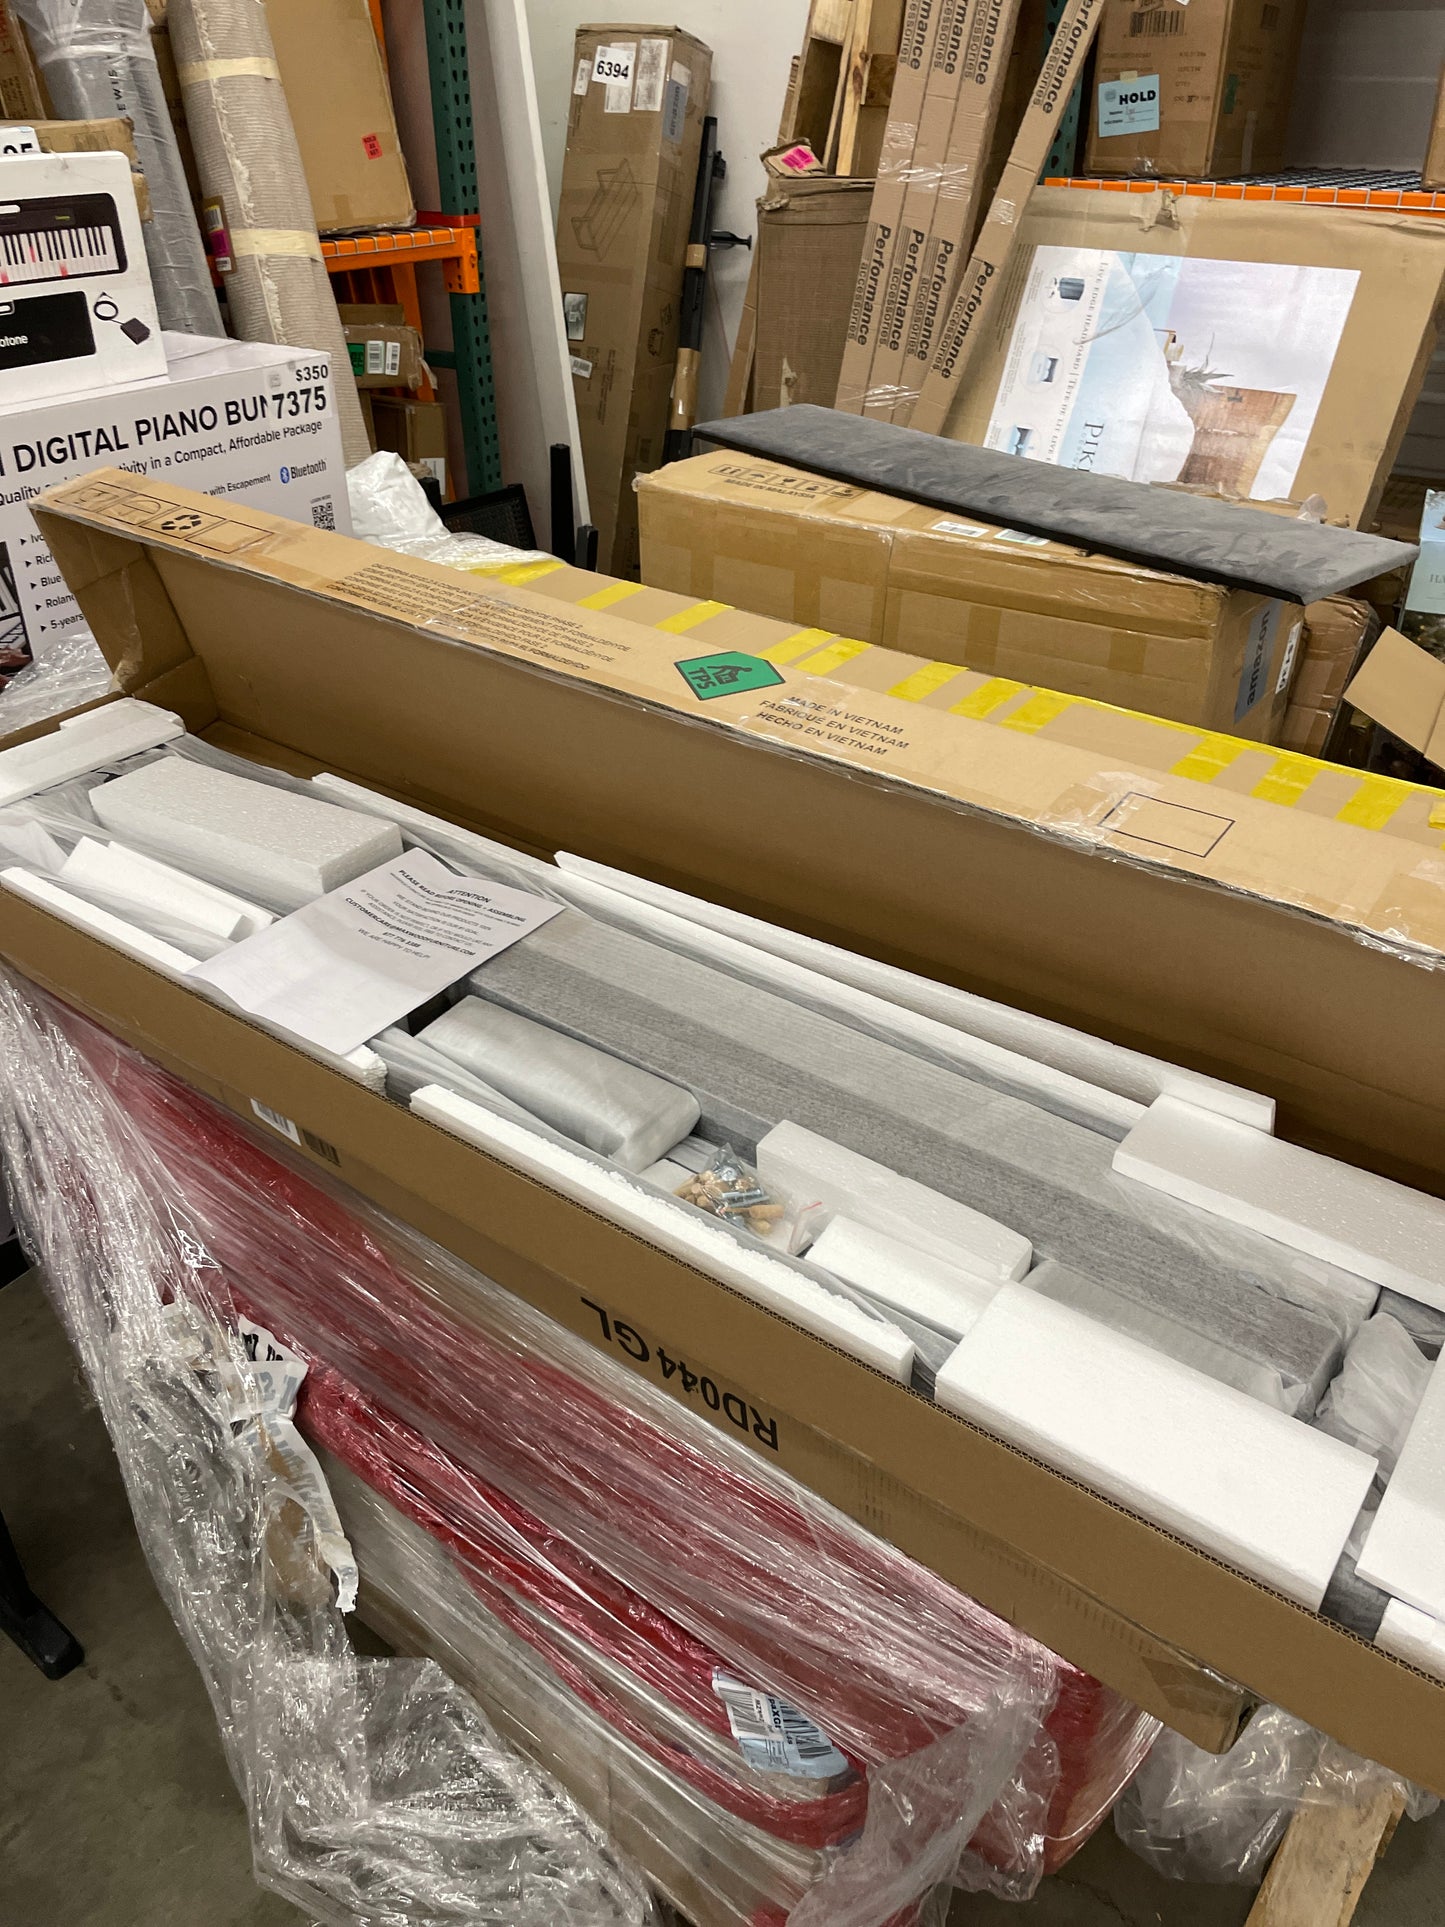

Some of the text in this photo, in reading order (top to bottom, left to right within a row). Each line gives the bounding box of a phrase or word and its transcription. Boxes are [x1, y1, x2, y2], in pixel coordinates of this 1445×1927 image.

[596, 60, 629, 78] 6394
[1119, 90, 1156, 105] HOLD
[857, 224, 892, 346] Performance
[889, 228, 925, 351] Performance
[917, 239, 954, 361] Performance
[941, 261, 995, 378] Performance
[295, 364, 328, 382] $350
[271, 385, 327, 419] 7375
[12, 424, 130, 474] DIGITAL
[135, 405, 218, 445] PIANO
[150, 457, 162, 469] in
[165, 456, 172, 466] a
[174, 442, 227, 464] Compact,
[229, 430, 281, 451] Affordable
[283, 421, 323, 439] Package
[209, 473, 271, 496] with Escapement
[290, 459, 327, 480] Bluetooth
[765, 486, 816, 499] MALAYSIA
[50, 613, 84, 629] 5-years
[687, 667, 716, 690] TPS
[787, 696, 904, 735] MADE IN VIETNAM
[755, 711, 888, 756] HECHO EN VIETNAM
[827, 719, 849, 731] EN
[848, 725, 910, 750] VIETNAM
[399, 869, 421, 886] PLEASE
[487, 908, 527, 923] ASSEMBLING
[447, 889, 492, 903] ATTENTION
